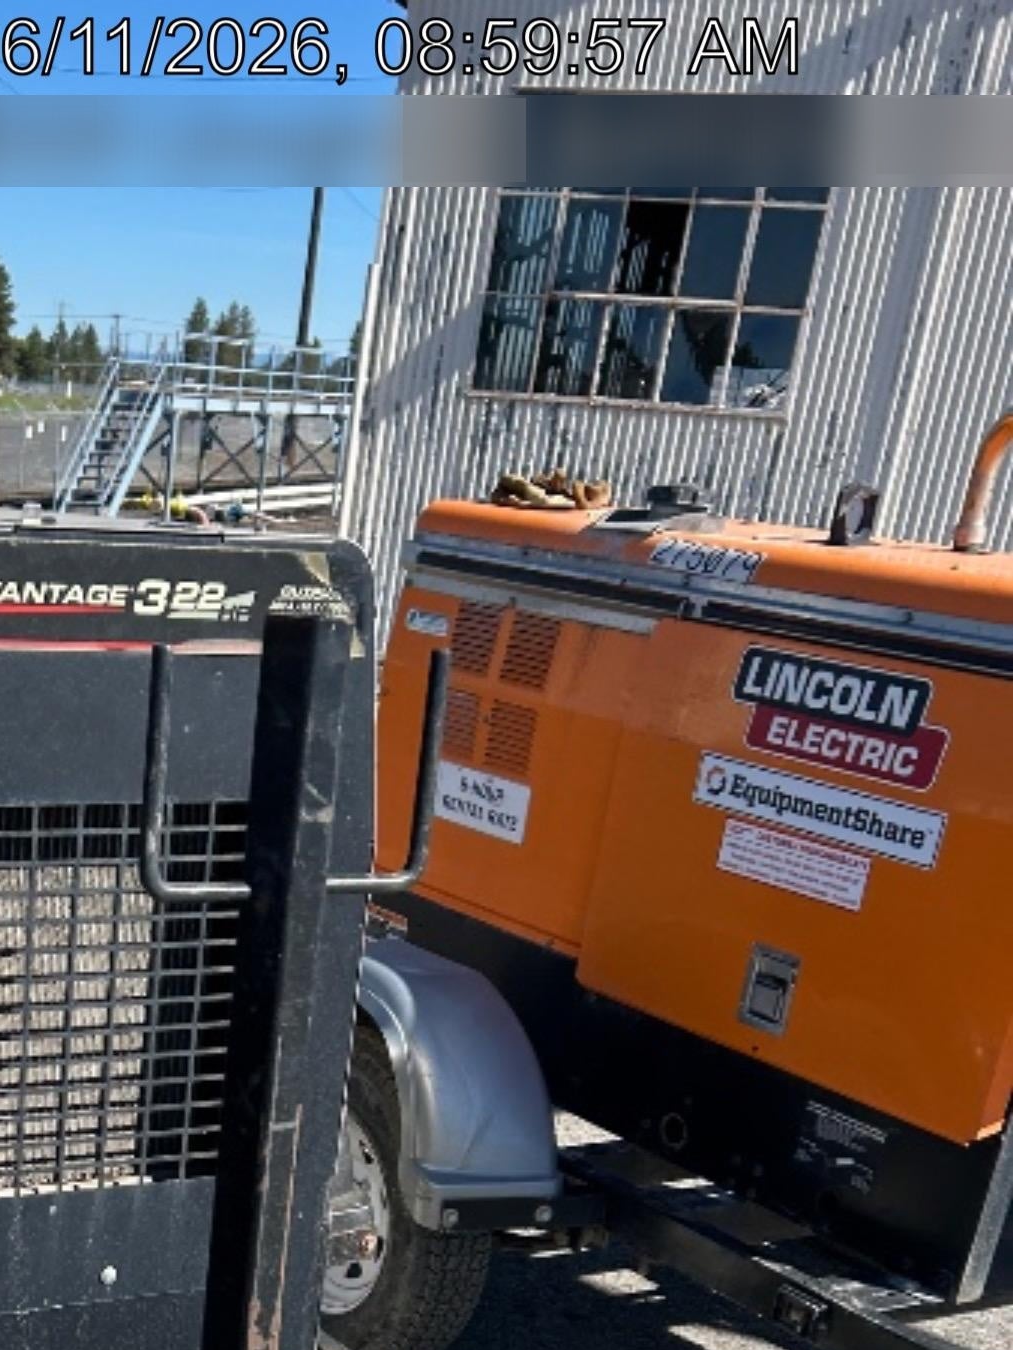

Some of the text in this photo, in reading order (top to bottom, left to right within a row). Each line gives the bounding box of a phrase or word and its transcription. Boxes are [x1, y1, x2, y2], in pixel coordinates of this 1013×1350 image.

[133, 578, 226, 616] 322
[743, 656, 918, 729] LINCOLN
[766, 716, 919, 776] ELECTRIC
[728, 773, 926, 850] EquipmentShare
